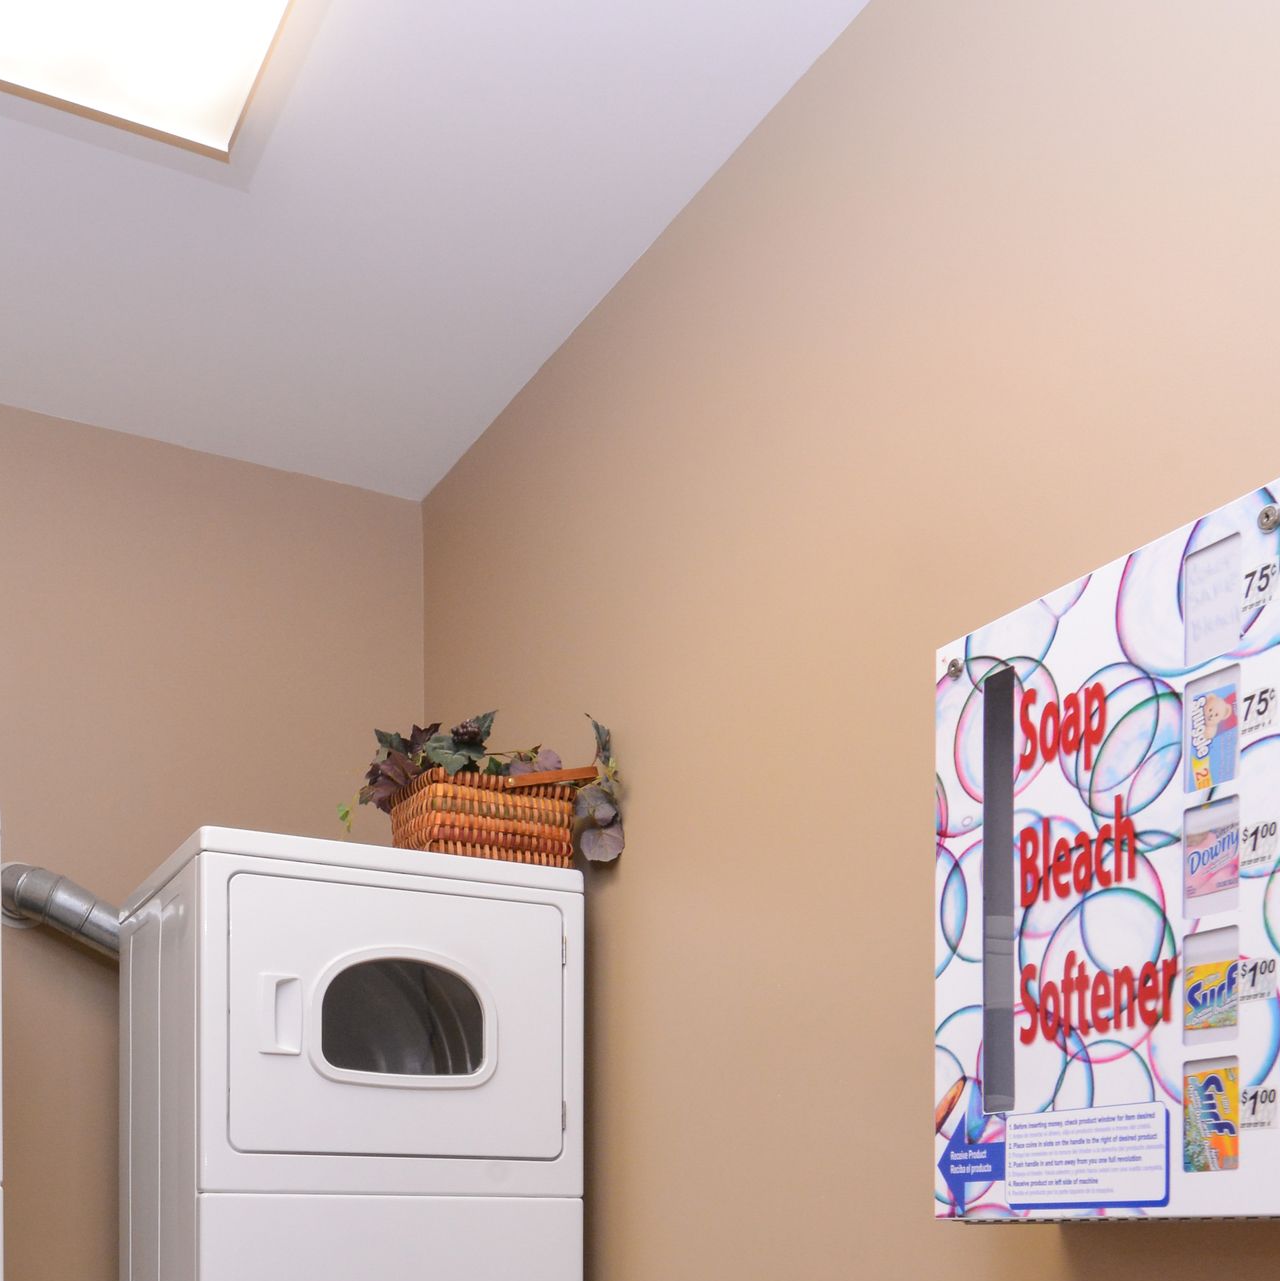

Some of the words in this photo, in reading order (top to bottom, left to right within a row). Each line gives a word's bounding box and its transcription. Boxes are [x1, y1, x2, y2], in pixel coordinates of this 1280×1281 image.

[1019, 680, 1108, 773] Soap
[1191, 695, 1212, 760] Snuggle
[1019, 793, 1137, 908] Bleach
[1187, 829, 1239, 876] Downy
[1019, 949, 1178, 1046] Softener
[1187, 962, 1239, 1013] Surf
[1013, 1122, 1027, 1130] Before
[1079, 1117, 1096, 1126] product
[1098, 1115, 1115, 1123] window
[1137, 1112, 1156, 1120] desired
[1196, 1074, 1236, 1136] Surf
[950, 1151, 968, 1160] Receive
[968, 1149, 987, 1159] Product
[1077, 1157, 1088, 1165] from
[1108, 1155, 1116, 1163] full
[1100, 1135, 1112, 1144] right
[1119, 1134, 1136, 1142] desired
[1137, 1132, 1157, 1142] product
[1030, 1179, 1047, 1187] product
